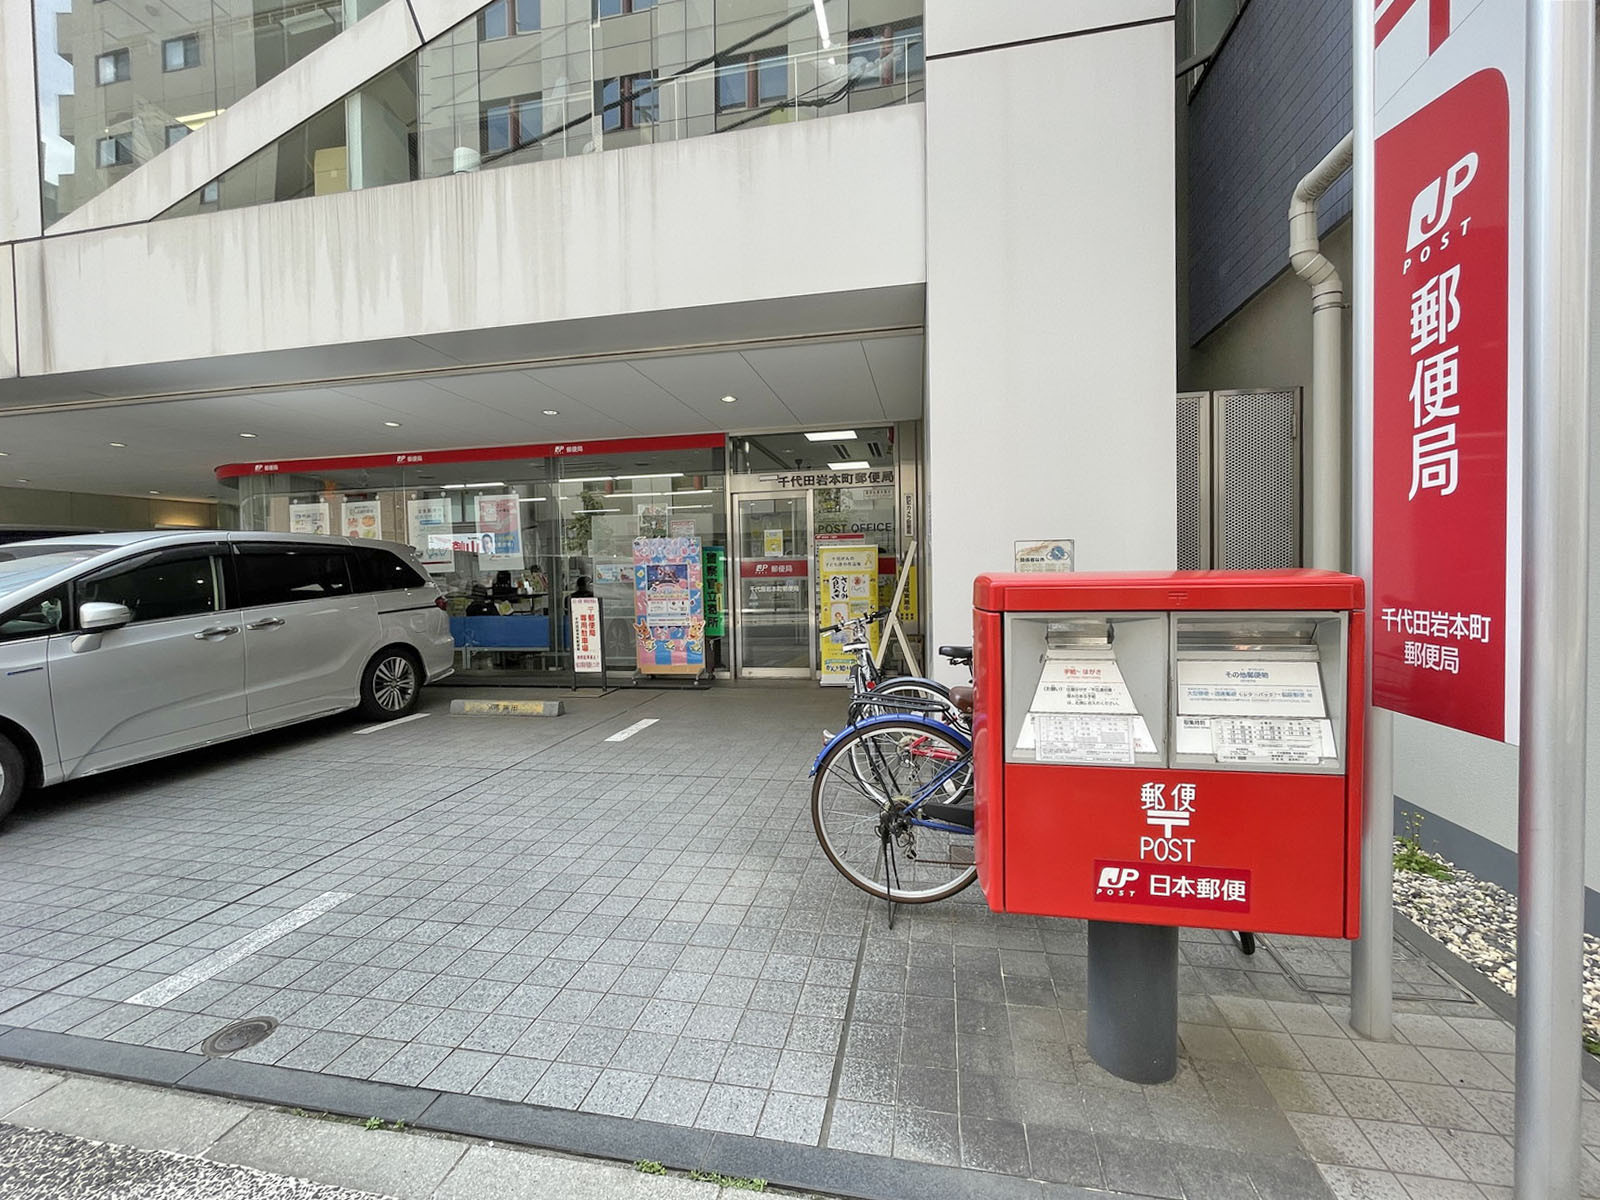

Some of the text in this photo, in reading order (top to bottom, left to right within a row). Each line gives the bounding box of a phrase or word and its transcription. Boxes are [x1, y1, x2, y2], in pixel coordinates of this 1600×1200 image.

[1406, 152, 1479, 253] JP
[1403, 216, 1472, 275] POST
[1408, 264, 1461, 501] 郵便局
[777, 471, 894, 488] 千代田岩本町郵便局
[817, 522, 893, 534] POST OFFICE
[1381, 607, 1491, 643] 千代田岩本町
[1404, 640, 1459, 674] 郵便局
[1140, 782, 1196, 812] 郵便
[1140, 836, 1196, 863] POST
[1096, 888, 1136, 897] POST
[1098, 867, 1246, 902] JP 日本郵便
